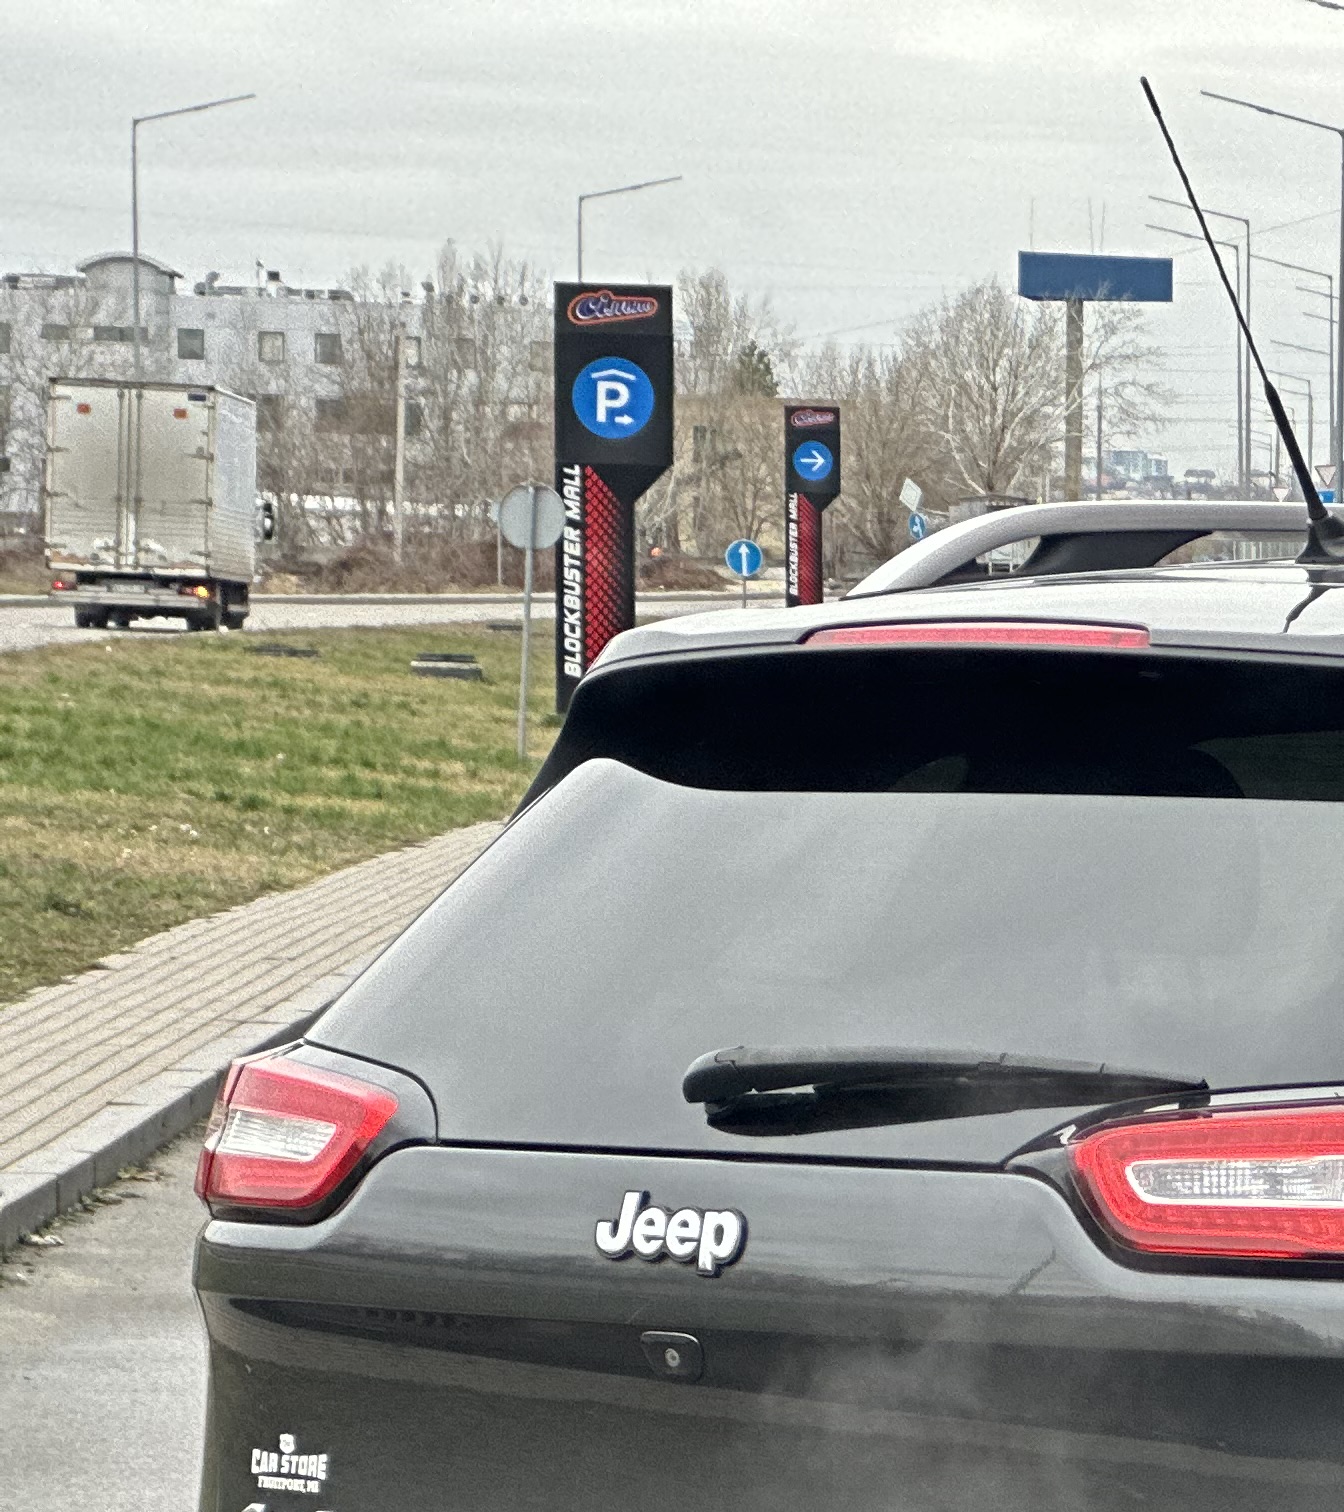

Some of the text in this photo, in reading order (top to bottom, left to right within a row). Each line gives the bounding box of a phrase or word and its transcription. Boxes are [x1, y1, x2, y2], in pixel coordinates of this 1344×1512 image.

[596, 380, 630, 423] P
[562, 463, 583, 679] BLOCKBUSTER MALL
[595, 1190, 745, 1275] Jeep
[251, 1448, 328, 1480] CAR STORE
